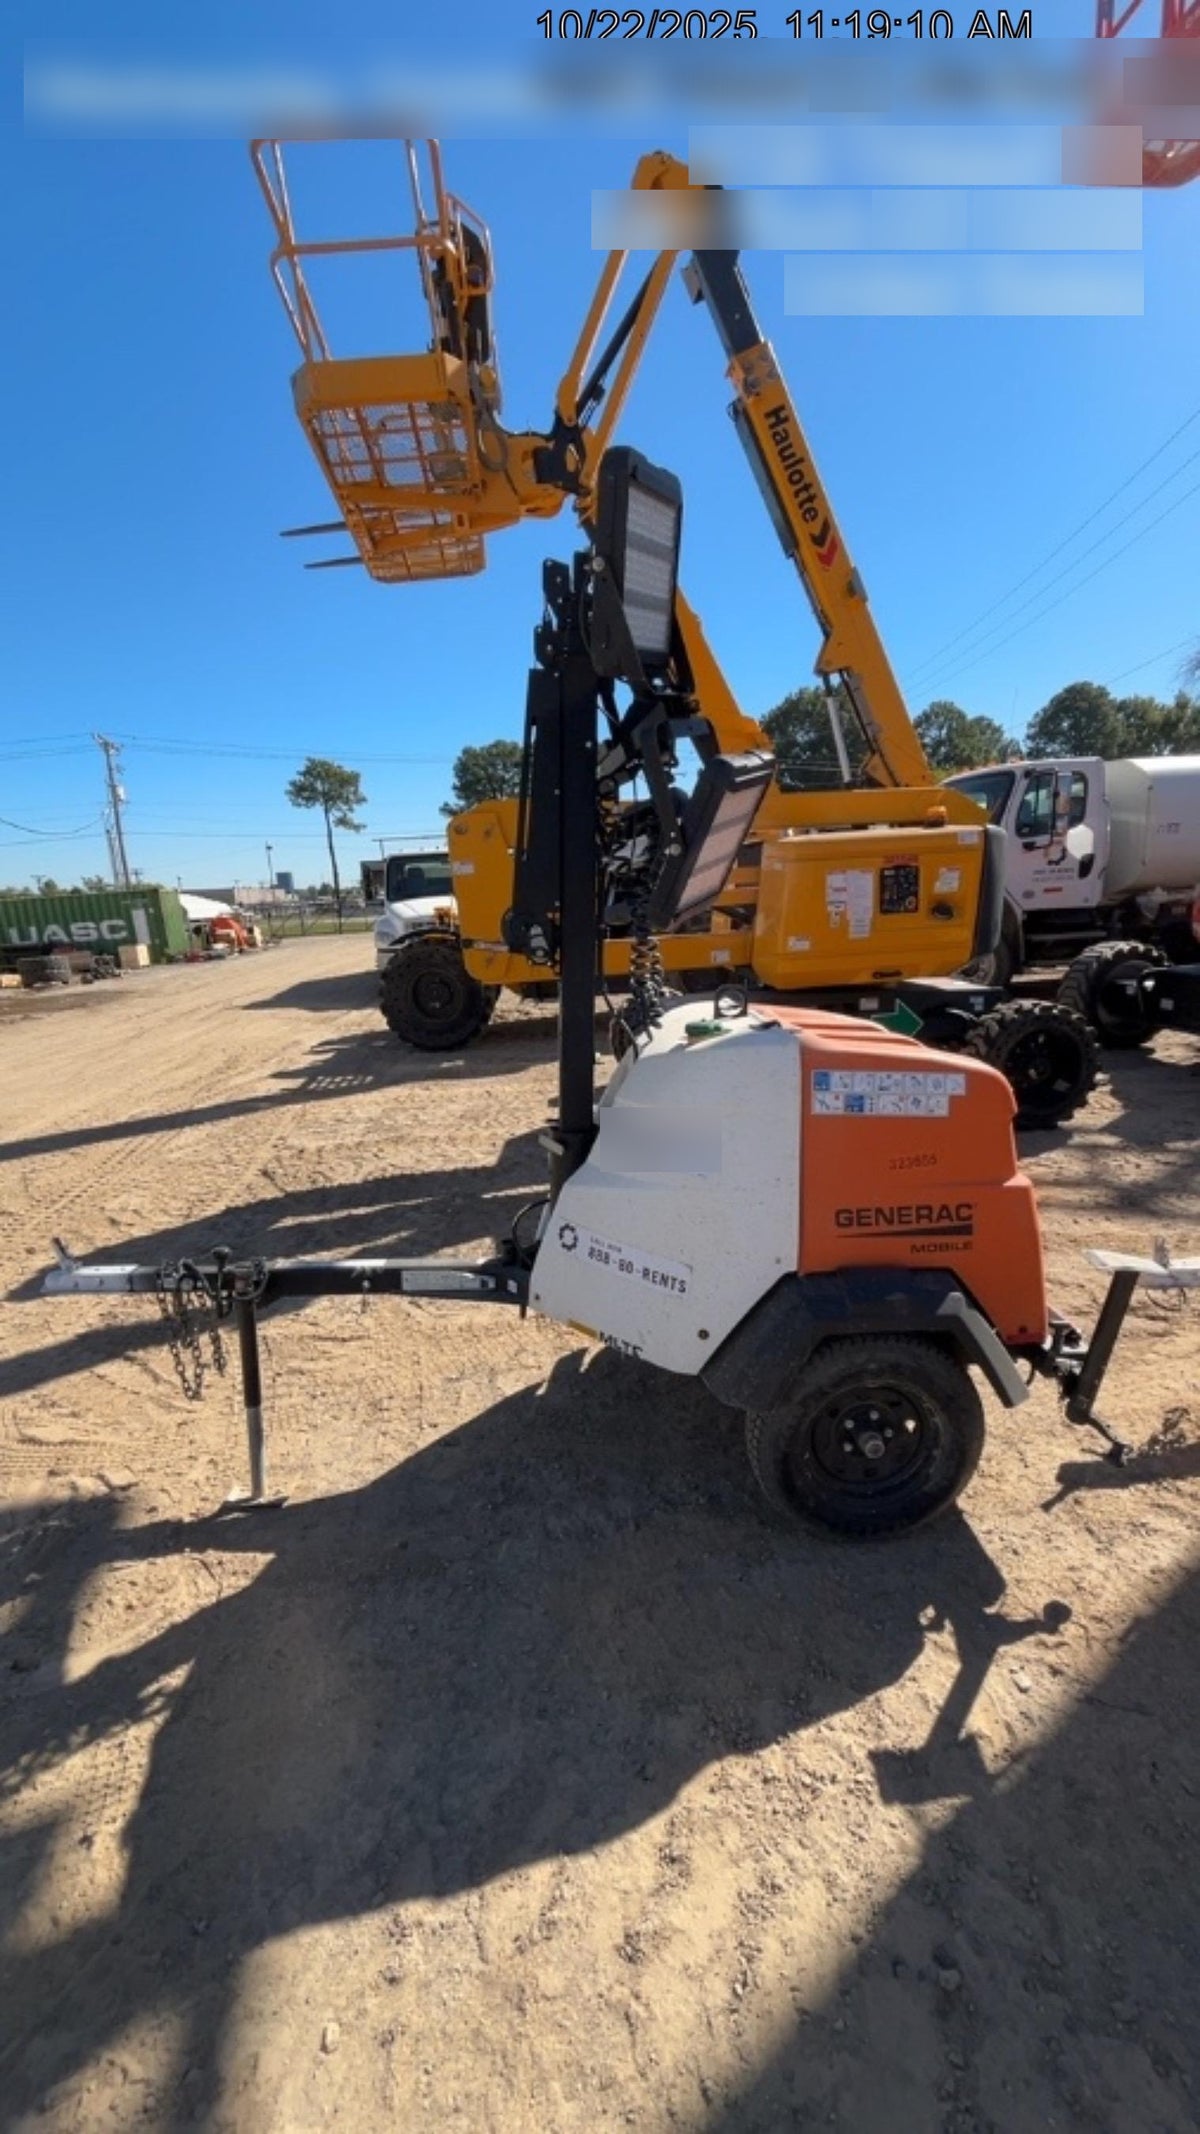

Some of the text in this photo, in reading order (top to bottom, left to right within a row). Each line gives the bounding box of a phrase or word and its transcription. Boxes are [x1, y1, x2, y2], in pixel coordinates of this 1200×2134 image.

[764, 405, 819, 523] Haulotte
[9, 919, 128, 945] UASC
[835, 1203, 973, 1228] GENERAC
[910, 1241, 973, 1255] MOBILE
